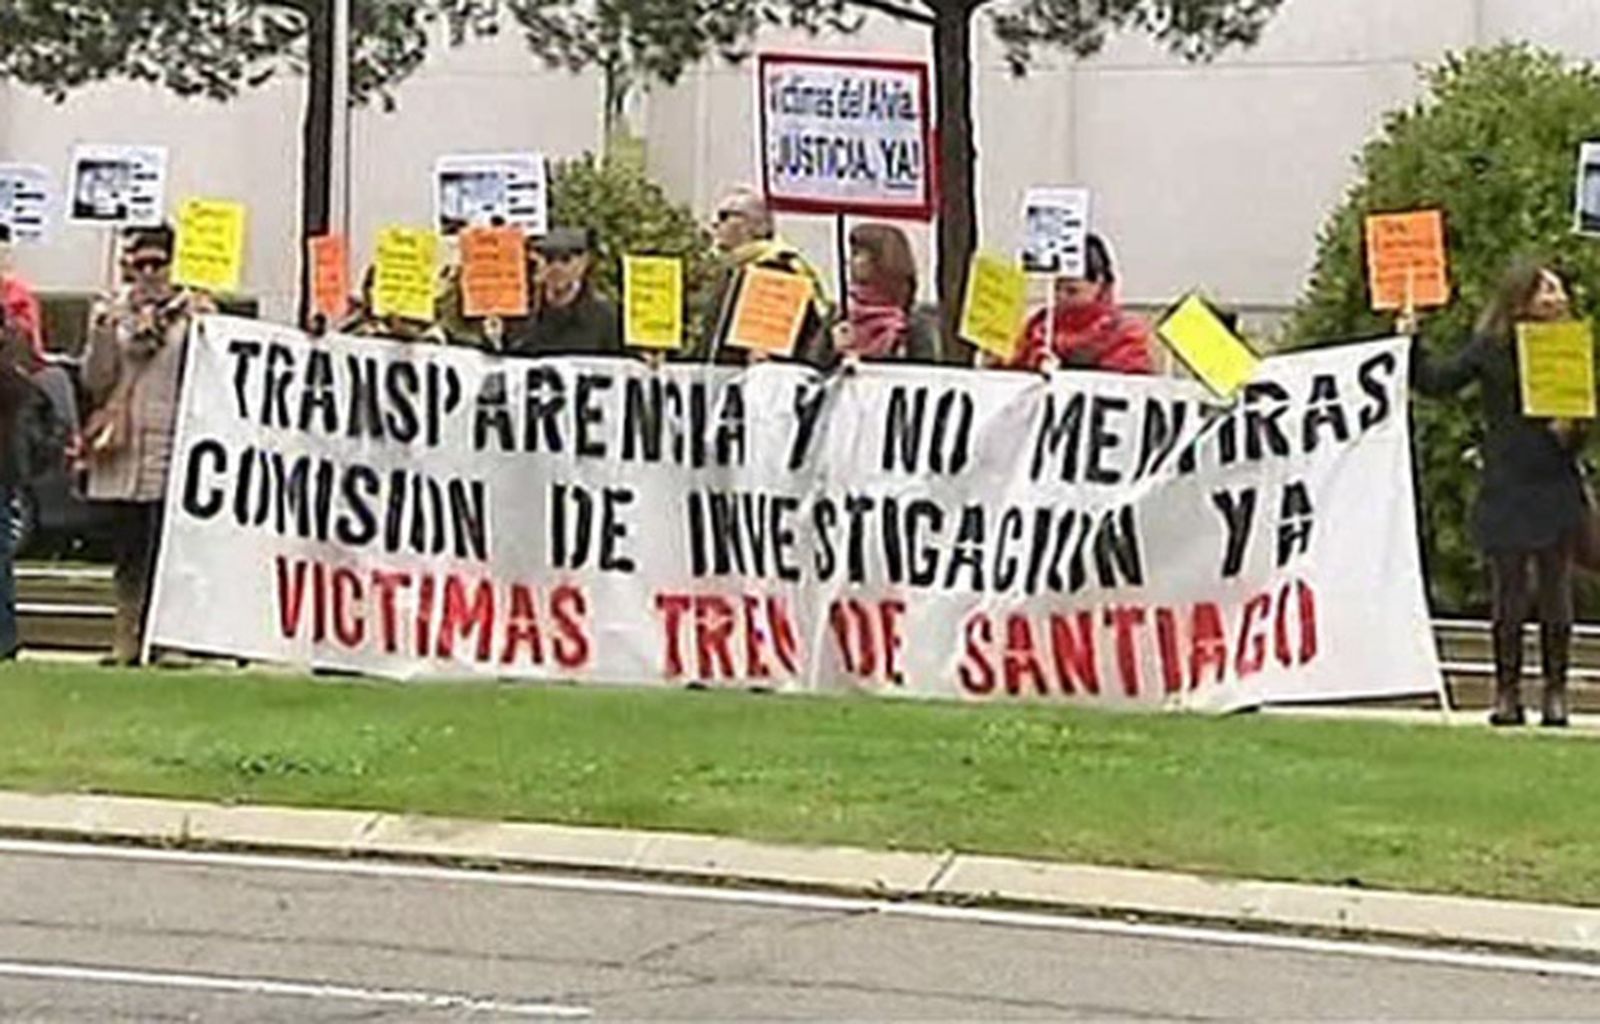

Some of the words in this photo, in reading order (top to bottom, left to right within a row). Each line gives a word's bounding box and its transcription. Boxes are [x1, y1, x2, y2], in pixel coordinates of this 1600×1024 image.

[229, 340, 746, 469] TRANSPARENCIA
[788, 382, 827, 471] Y
[882, 385, 974, 475] NO
[182, 439, 488, 562] COMISION
[551, 481, 635, 573] DE
[689, 488, 1142, 595] INVESTIGACION
[1212, 480, 1314, 578] YA
[275, 555, 590, 669] VICTIMAS
[656, 593, 797, 680] TREN
[829, 600, 905, 686] DE
[959, 579, 1318, 698] SANTIAGO
